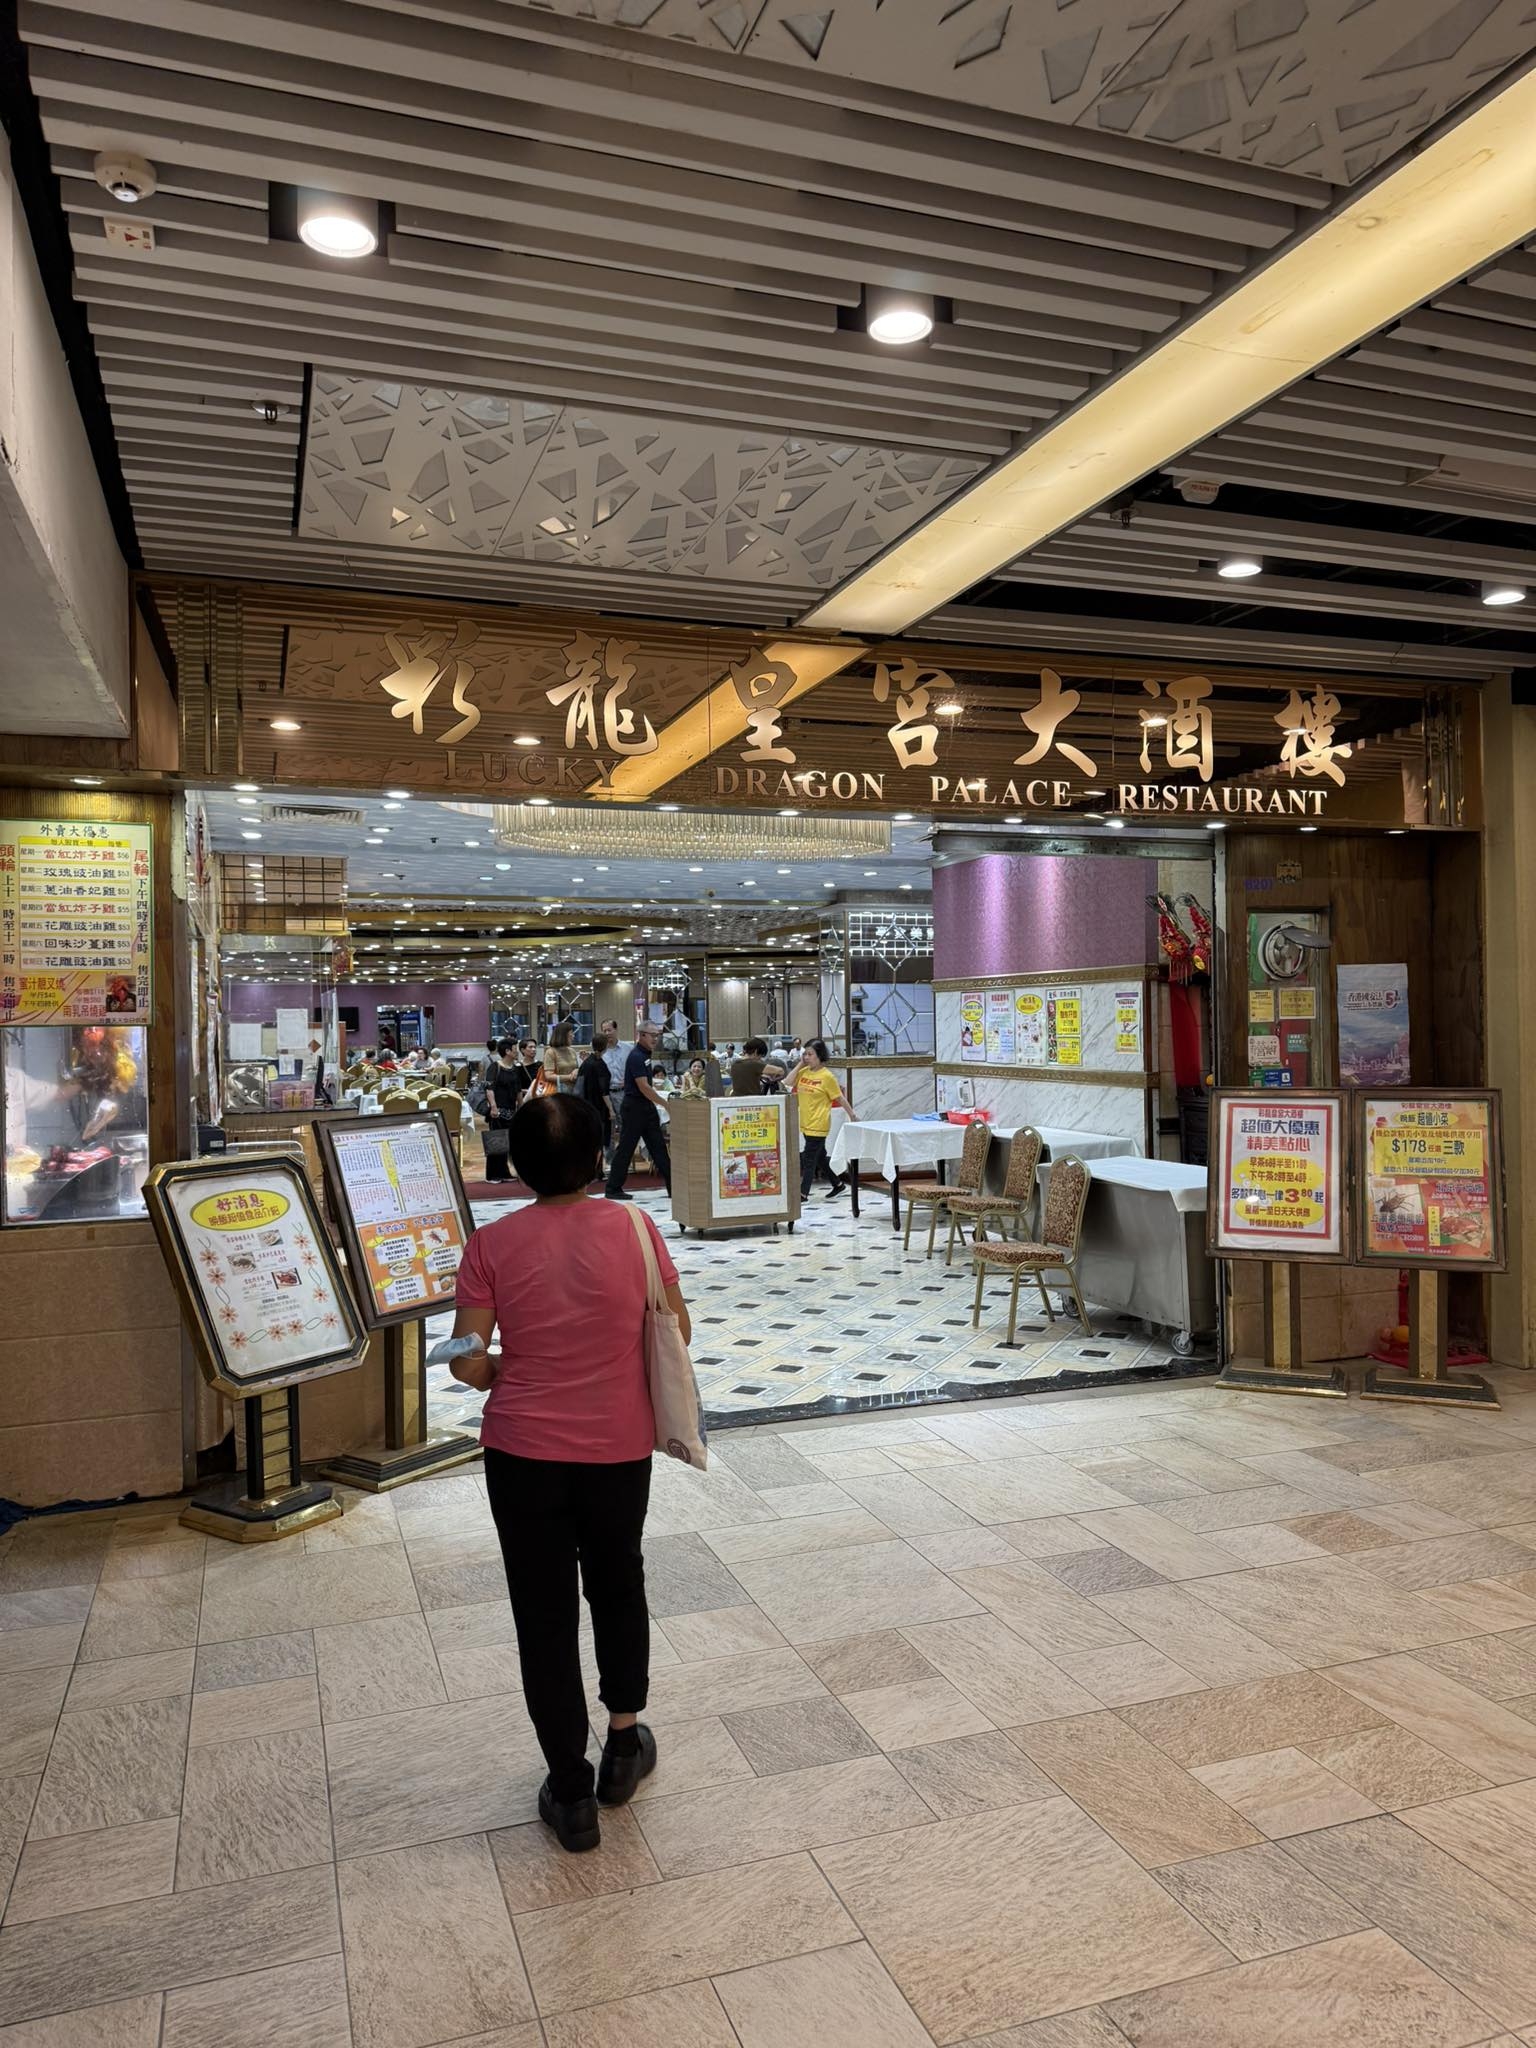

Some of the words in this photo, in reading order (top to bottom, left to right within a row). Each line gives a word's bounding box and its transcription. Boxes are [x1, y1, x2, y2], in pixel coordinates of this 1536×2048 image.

[380, 619, 1352, 787] 彩龍皇宮大酒樓
[443, 750, 620, 789] LUCKY
[715, 766, 886, 801] DRAGON
[930, 775, 1073, 808] PALACE
[1118, 783, 1328, 816] RESTAURANT
[137, 964, 149, 1009] 售完即止
[1241, 1119, 1320, 1135] 超值大優惠
[1247, 1136, 1311, 1152] 精美點心
[1392, 1138, 1427, 1154] $178
[216, 1193, 264, 1211] 好消息
